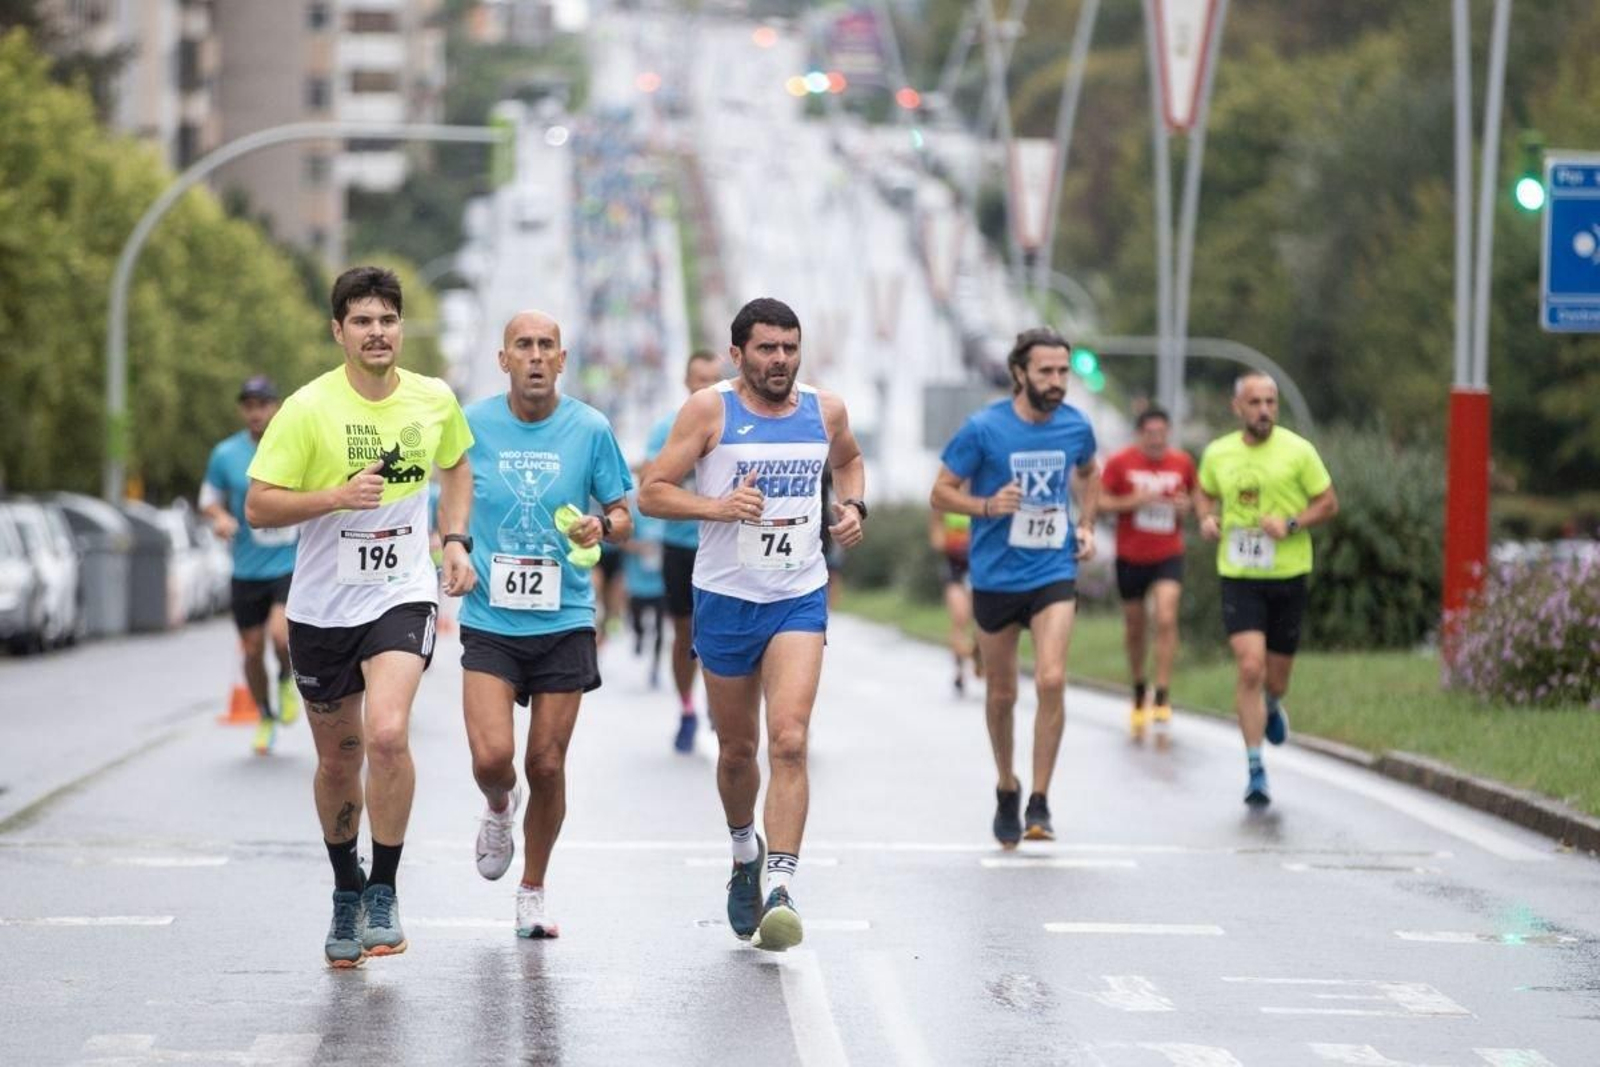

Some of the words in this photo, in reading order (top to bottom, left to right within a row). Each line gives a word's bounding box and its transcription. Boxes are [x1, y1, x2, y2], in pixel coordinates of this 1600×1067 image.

[352, 425, 379, 436] TRAIL
[347, 437, 369, 446] COVA
[371, 437, 382, 446] DA
[499, 450, 521, 459] VIGO
[523, 451, 559, 460] CONTRA
[500, 460, 513, 469] EL
[514, 458, 560, 470] CÁNCER
[736, 460, 822, 476] RUNNING
[1027, 518, 1056, 537] 176
[761, 532, 793, 557] 74
[358, 543, 398, 571] 196
[505, 571, 543, 595] 612
